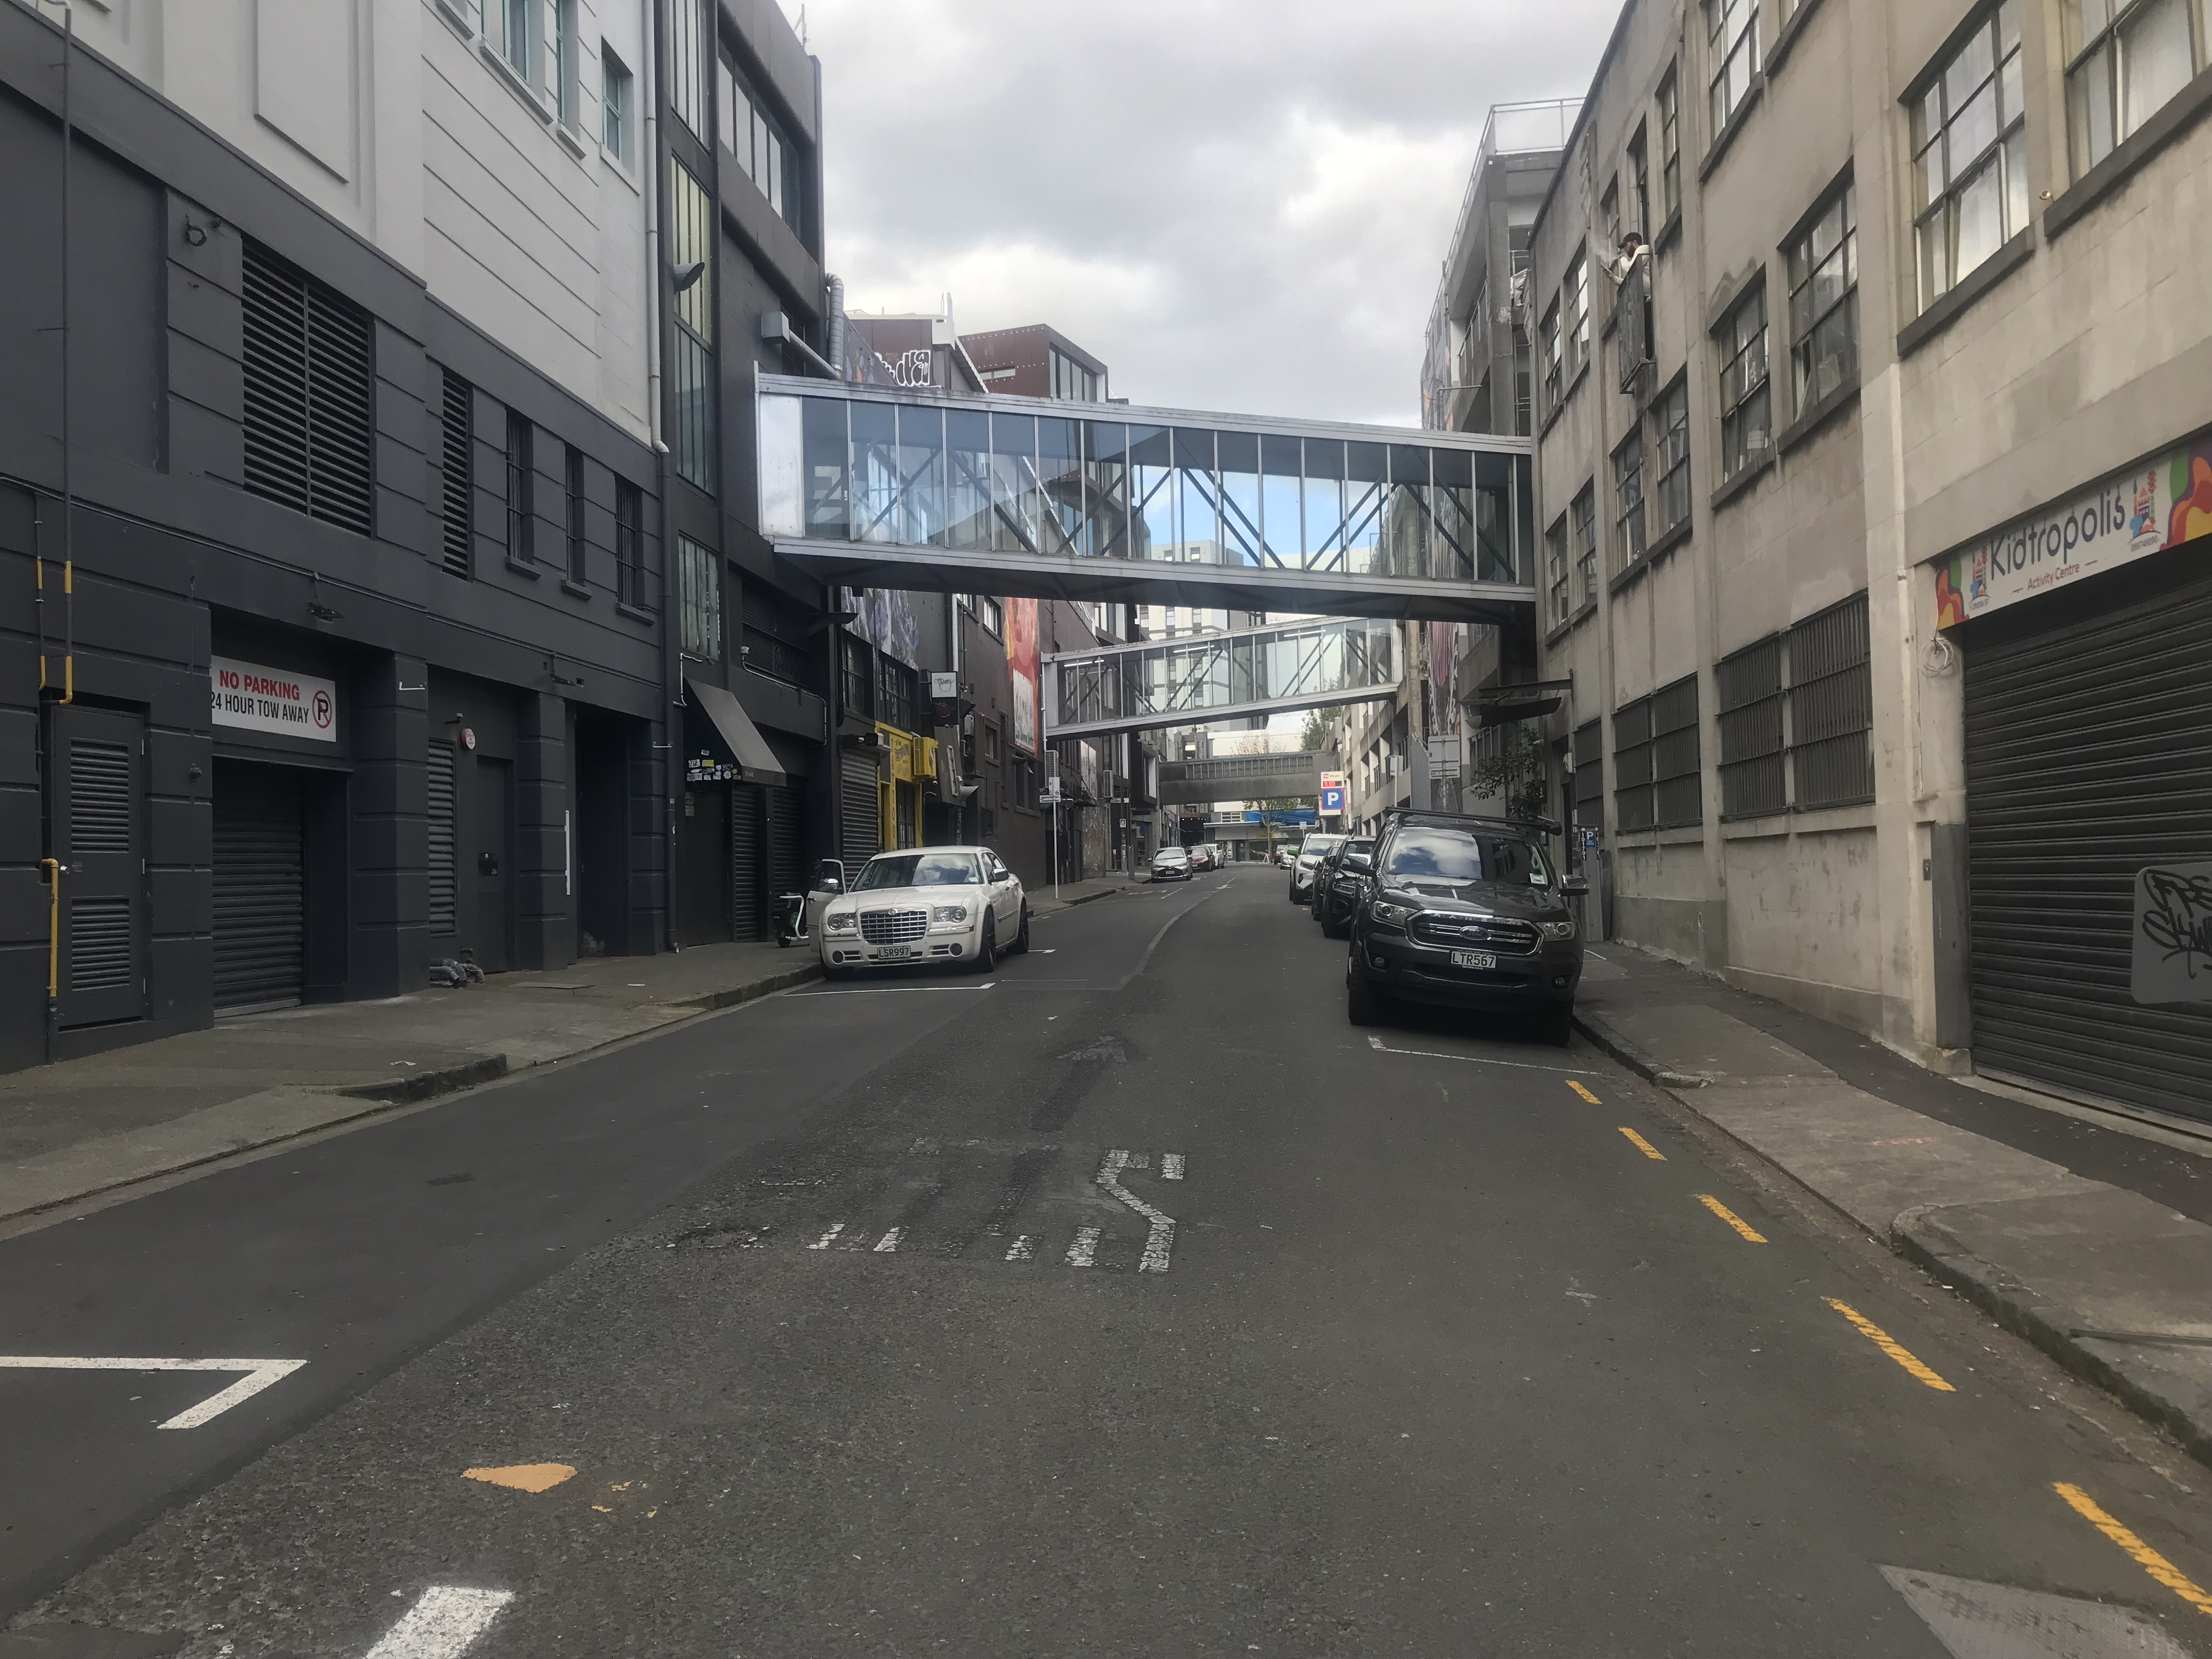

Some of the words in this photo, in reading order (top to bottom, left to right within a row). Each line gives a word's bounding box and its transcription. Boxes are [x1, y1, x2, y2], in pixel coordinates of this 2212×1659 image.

[1991, 489, 2125, 580] Kidtropolis
[2028, 572, 2054, 591] Activity
[2055, 563, 2080, 580] Centre
[219, 670, 240, 690] NO
[244, 674, 300, 701] PARKING
[212, 691, 222, 710] 24
[225, 694, 254, 715] HOUR
[257, 699, 279, 719] TOW
[282, 704, 309, 724] AWAY
[1328, 793, 1339, 805] P
[1587, 832, 1594, 840] P
[878, 947, 909, 958] LSR997
[1452, 952, 1495, 967] LTR567
